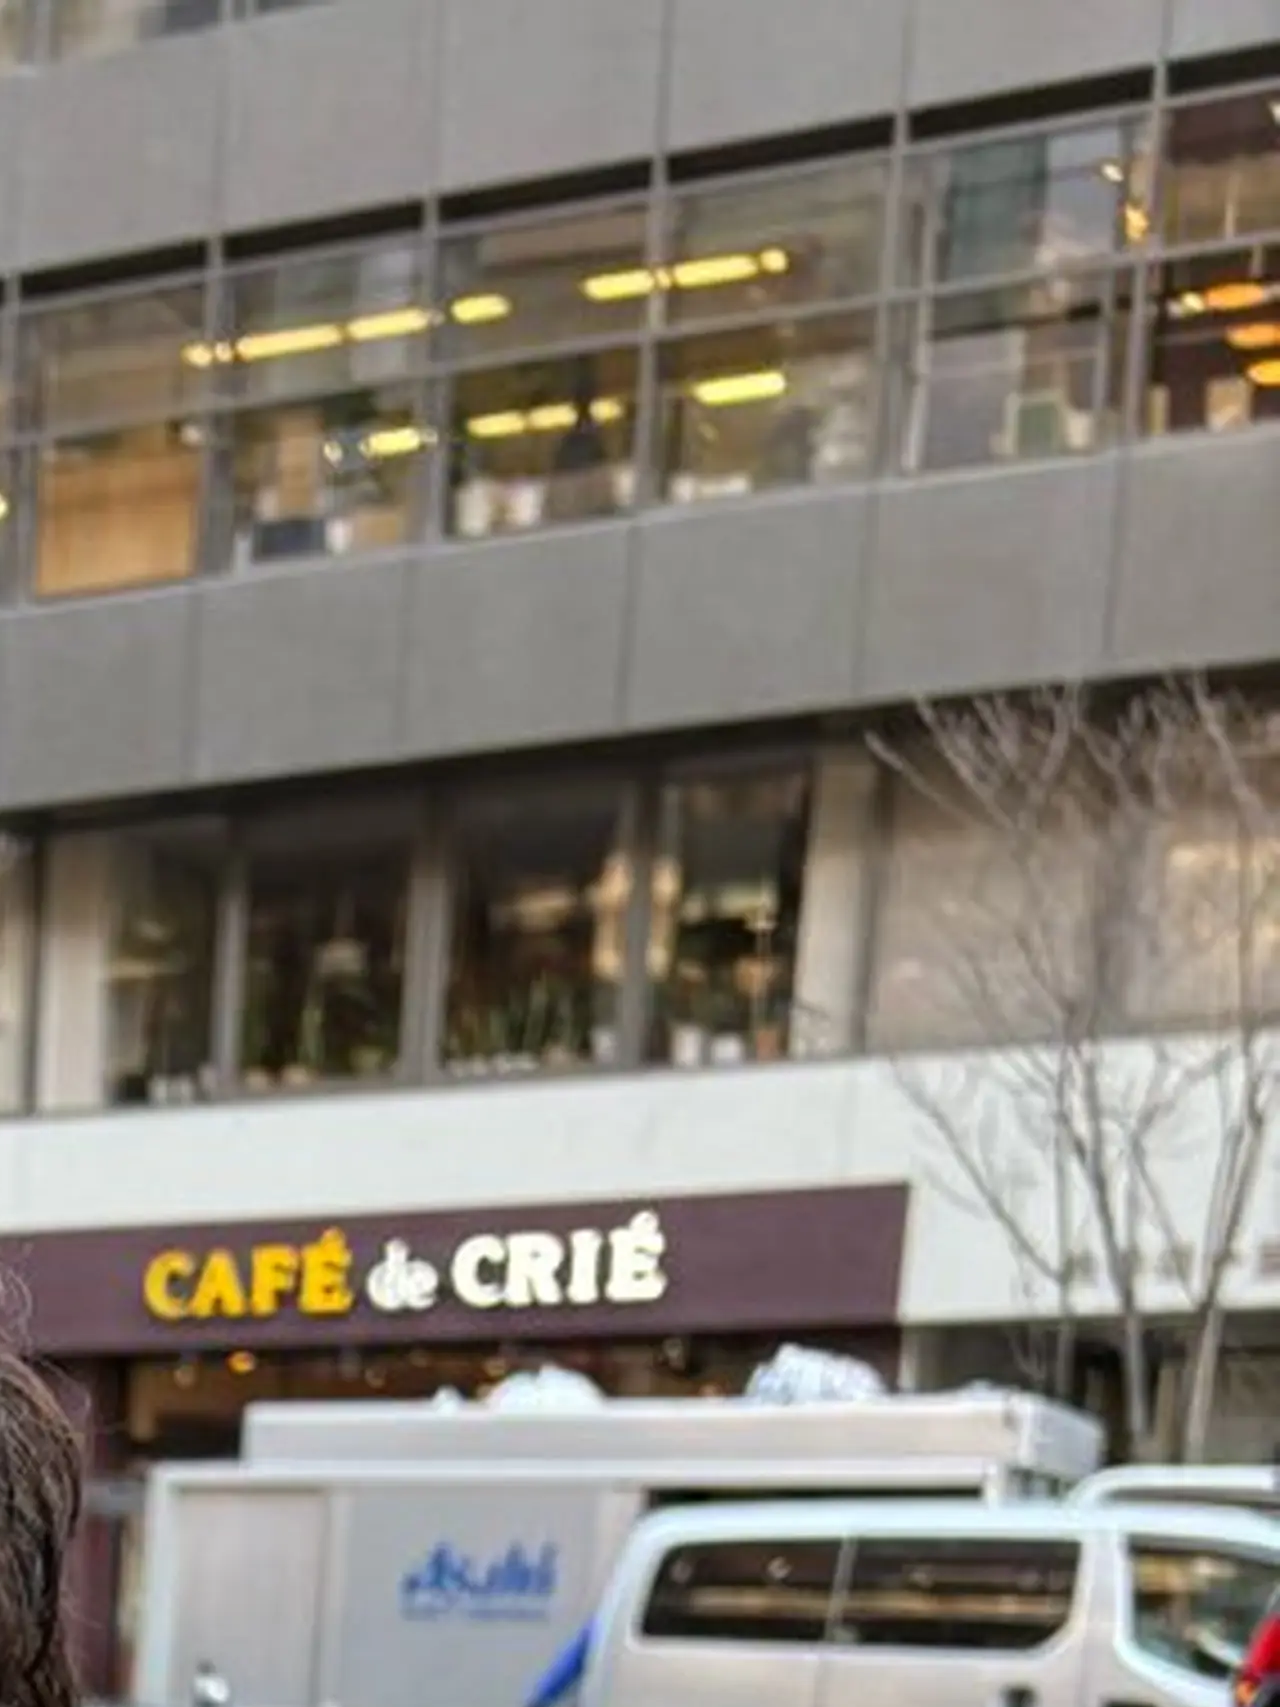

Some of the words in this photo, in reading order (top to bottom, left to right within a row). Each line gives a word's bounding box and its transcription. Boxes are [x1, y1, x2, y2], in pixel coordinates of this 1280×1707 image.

[143, 1227, 354, 1320] CAFÉ
[366, 1237, 438, 1311] de
[451, 1209, 666, 1308] CRIÉ
